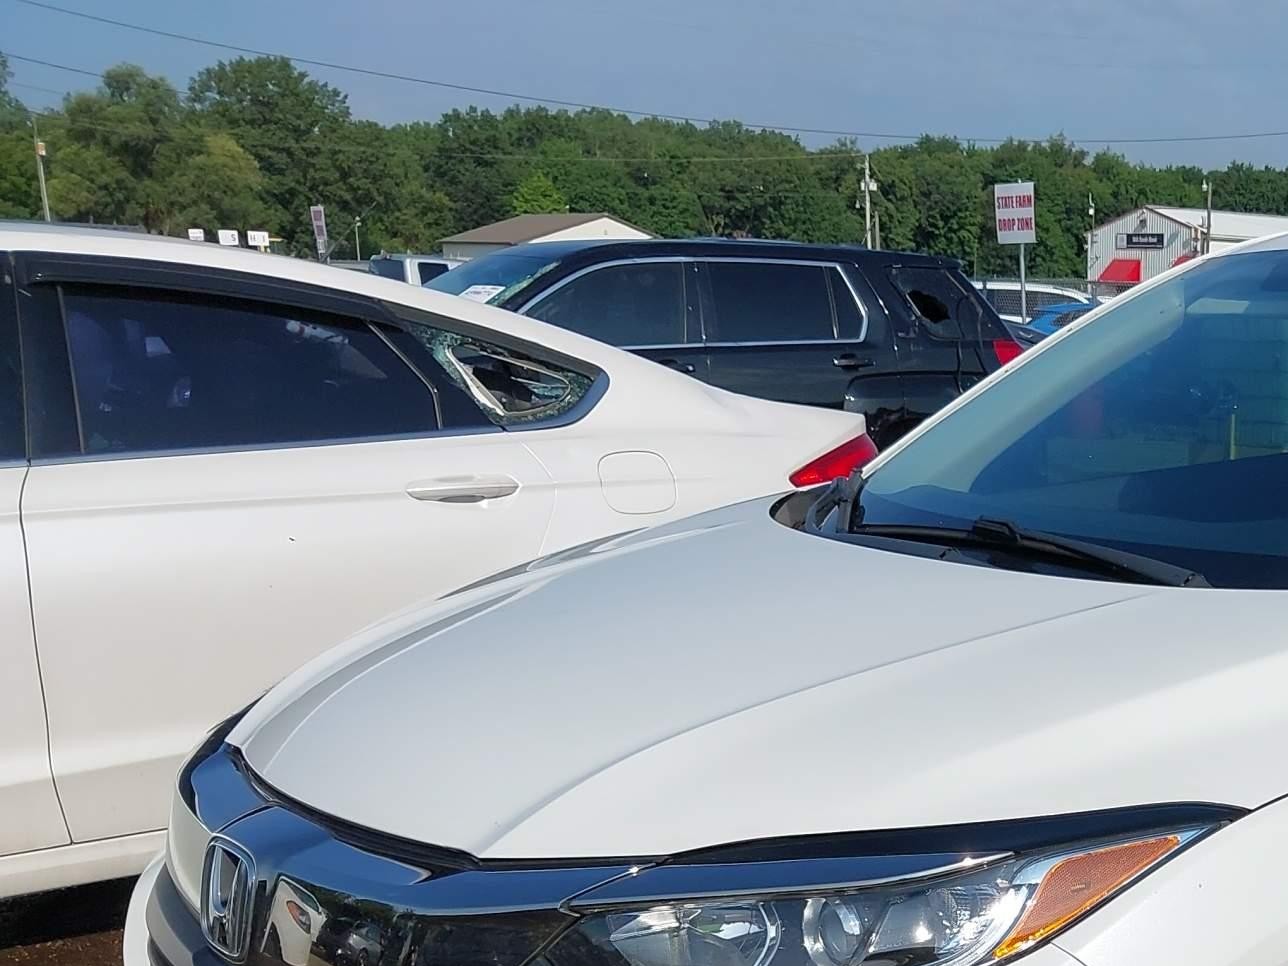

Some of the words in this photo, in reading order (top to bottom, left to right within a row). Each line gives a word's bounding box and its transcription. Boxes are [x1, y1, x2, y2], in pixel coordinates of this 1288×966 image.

[997, 196, 1014, 209] STATE
[1015, 194, 1032, 208] FARM
[998, 218, 1015, 231] DROP
[1017, 217, 1033, 231] ZONE
